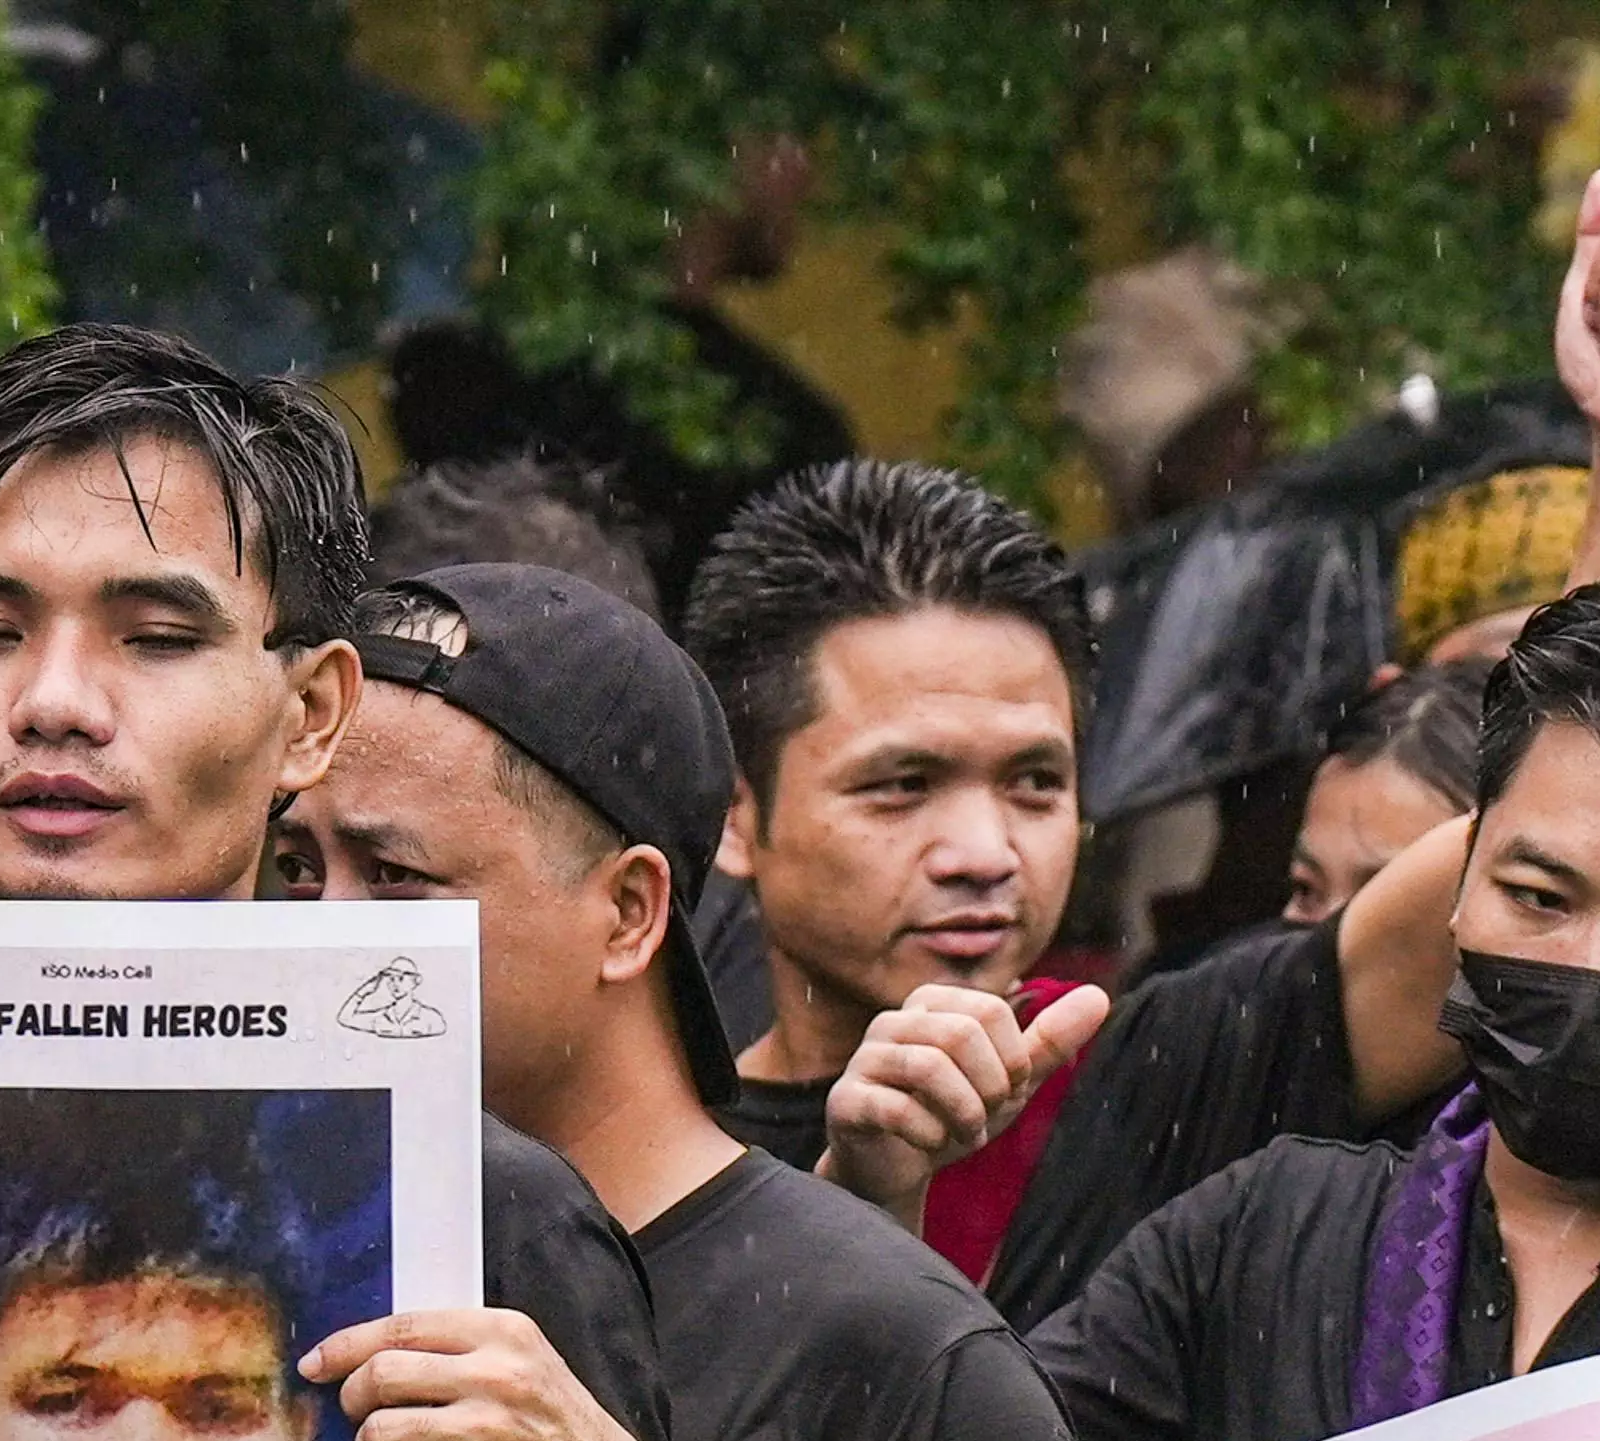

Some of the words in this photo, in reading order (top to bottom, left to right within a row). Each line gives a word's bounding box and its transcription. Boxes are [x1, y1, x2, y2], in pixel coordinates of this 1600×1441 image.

[75, 965, 119, 980] Media
[123, 965, 153, 980] Cell
[143, 1004, 288, 1038] HEROES
